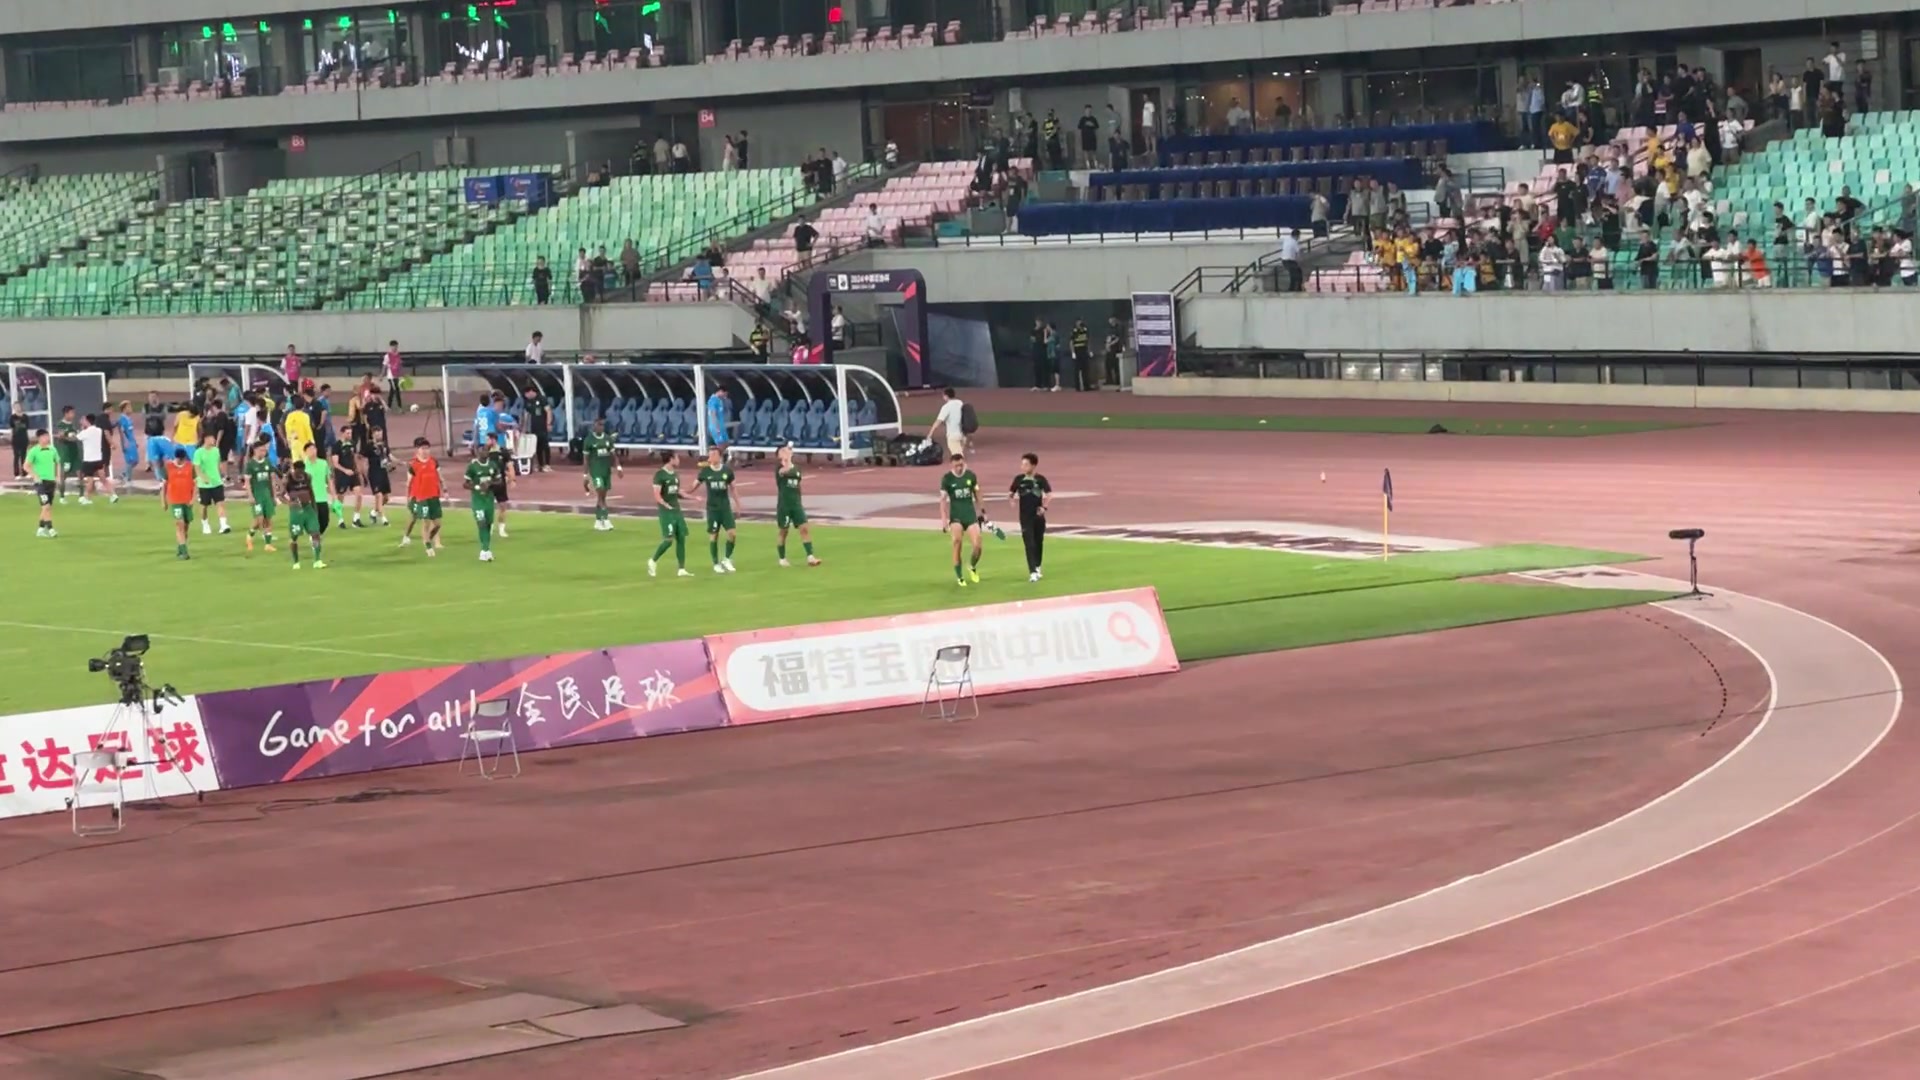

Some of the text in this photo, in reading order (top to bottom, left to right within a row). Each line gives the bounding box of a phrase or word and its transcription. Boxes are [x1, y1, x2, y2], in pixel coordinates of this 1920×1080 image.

[516, 669, 682, 727] 全民足球
[258, 710, 350, 757] Game
[358, 708, 416, 747] for
